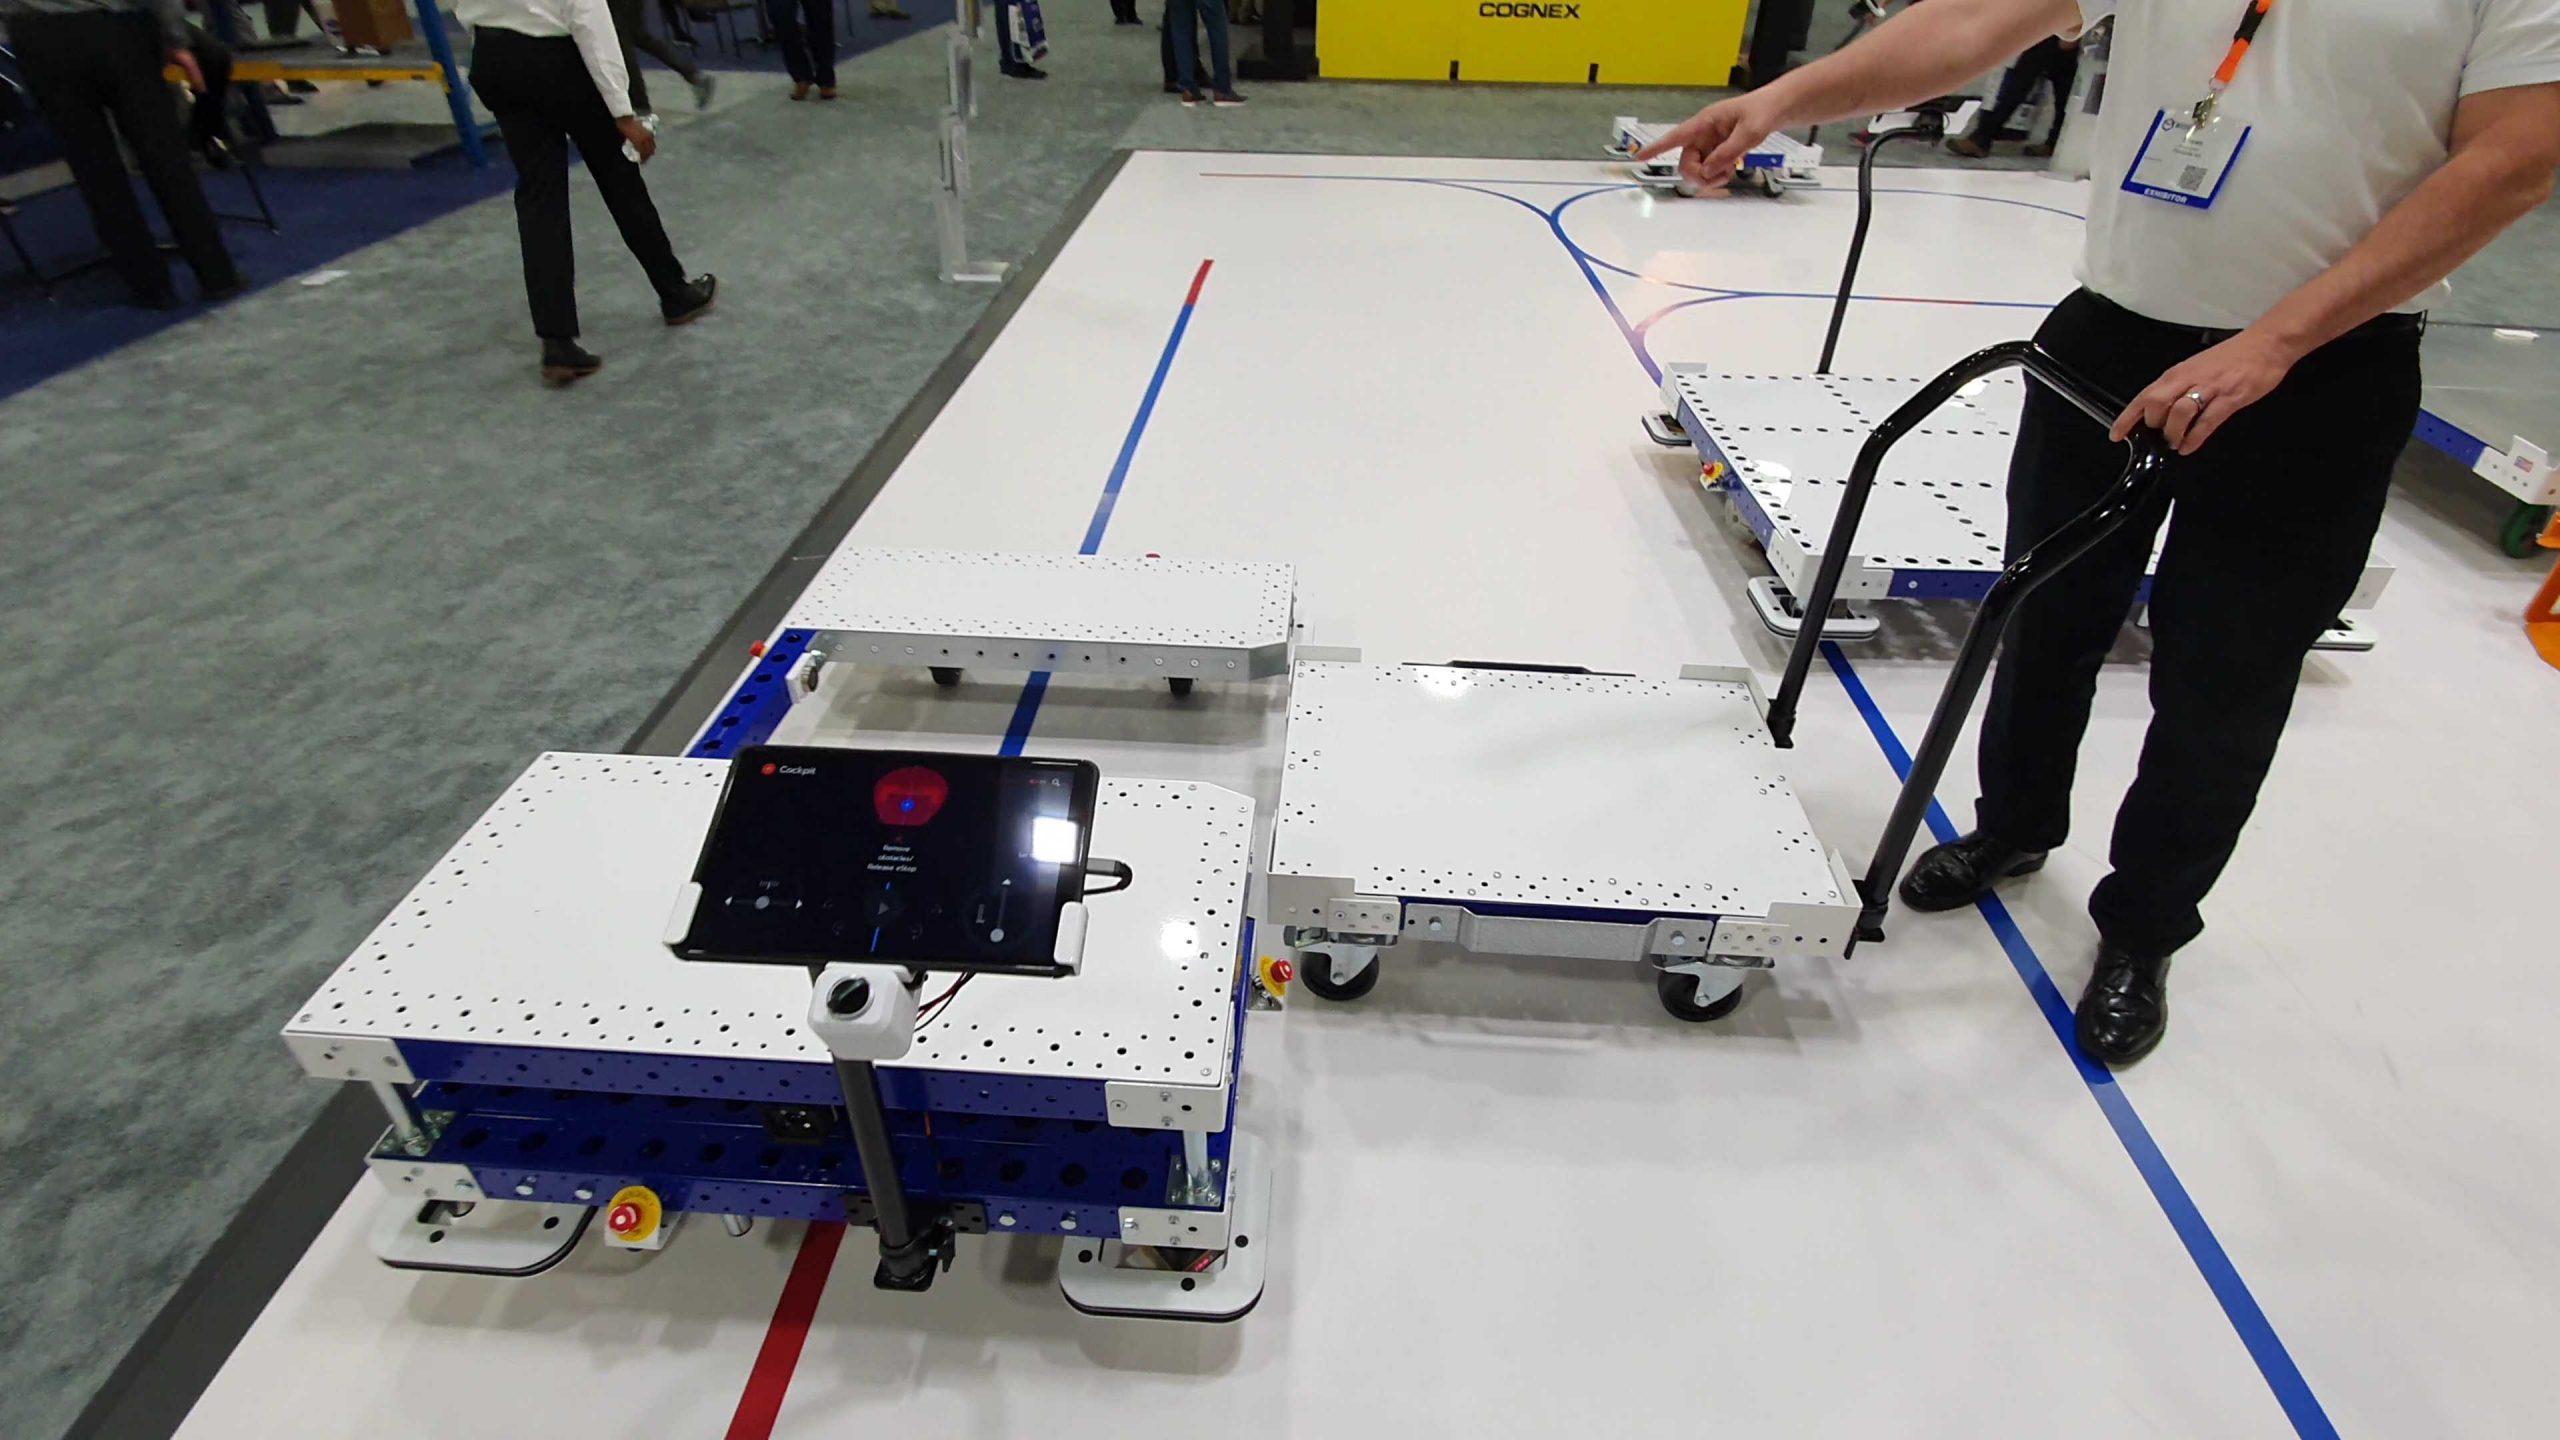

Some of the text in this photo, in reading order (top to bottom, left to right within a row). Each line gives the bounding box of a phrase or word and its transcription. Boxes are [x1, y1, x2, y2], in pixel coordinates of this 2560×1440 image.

[1480, 2, 1580, 19] COGNEX
[2143, 187, 2188, 204] EXHIBITOR
[779, 765, 817, 776] Cockpit
